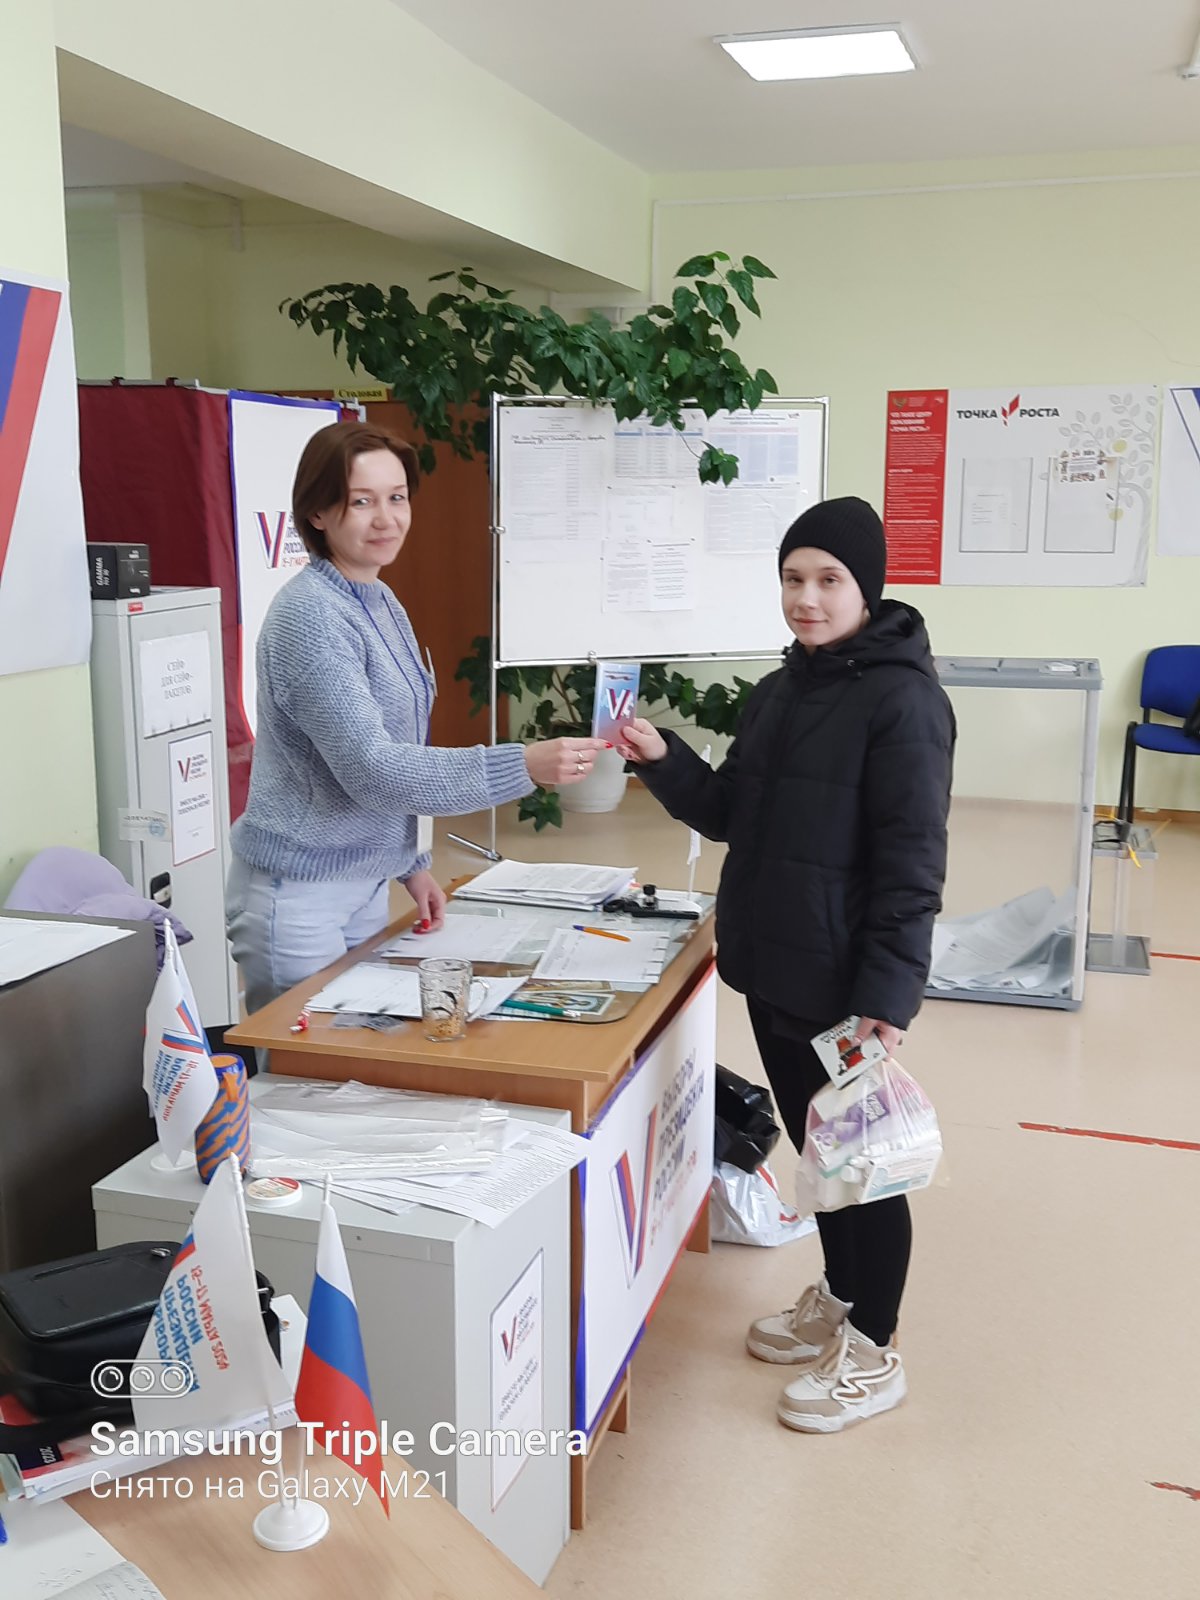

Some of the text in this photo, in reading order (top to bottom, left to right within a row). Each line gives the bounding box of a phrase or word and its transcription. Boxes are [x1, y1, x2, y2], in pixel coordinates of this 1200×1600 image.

[956, 408, 1060, 419] ТОЧКА РОСТА
[95, 556, 104, 586] GAMMA
